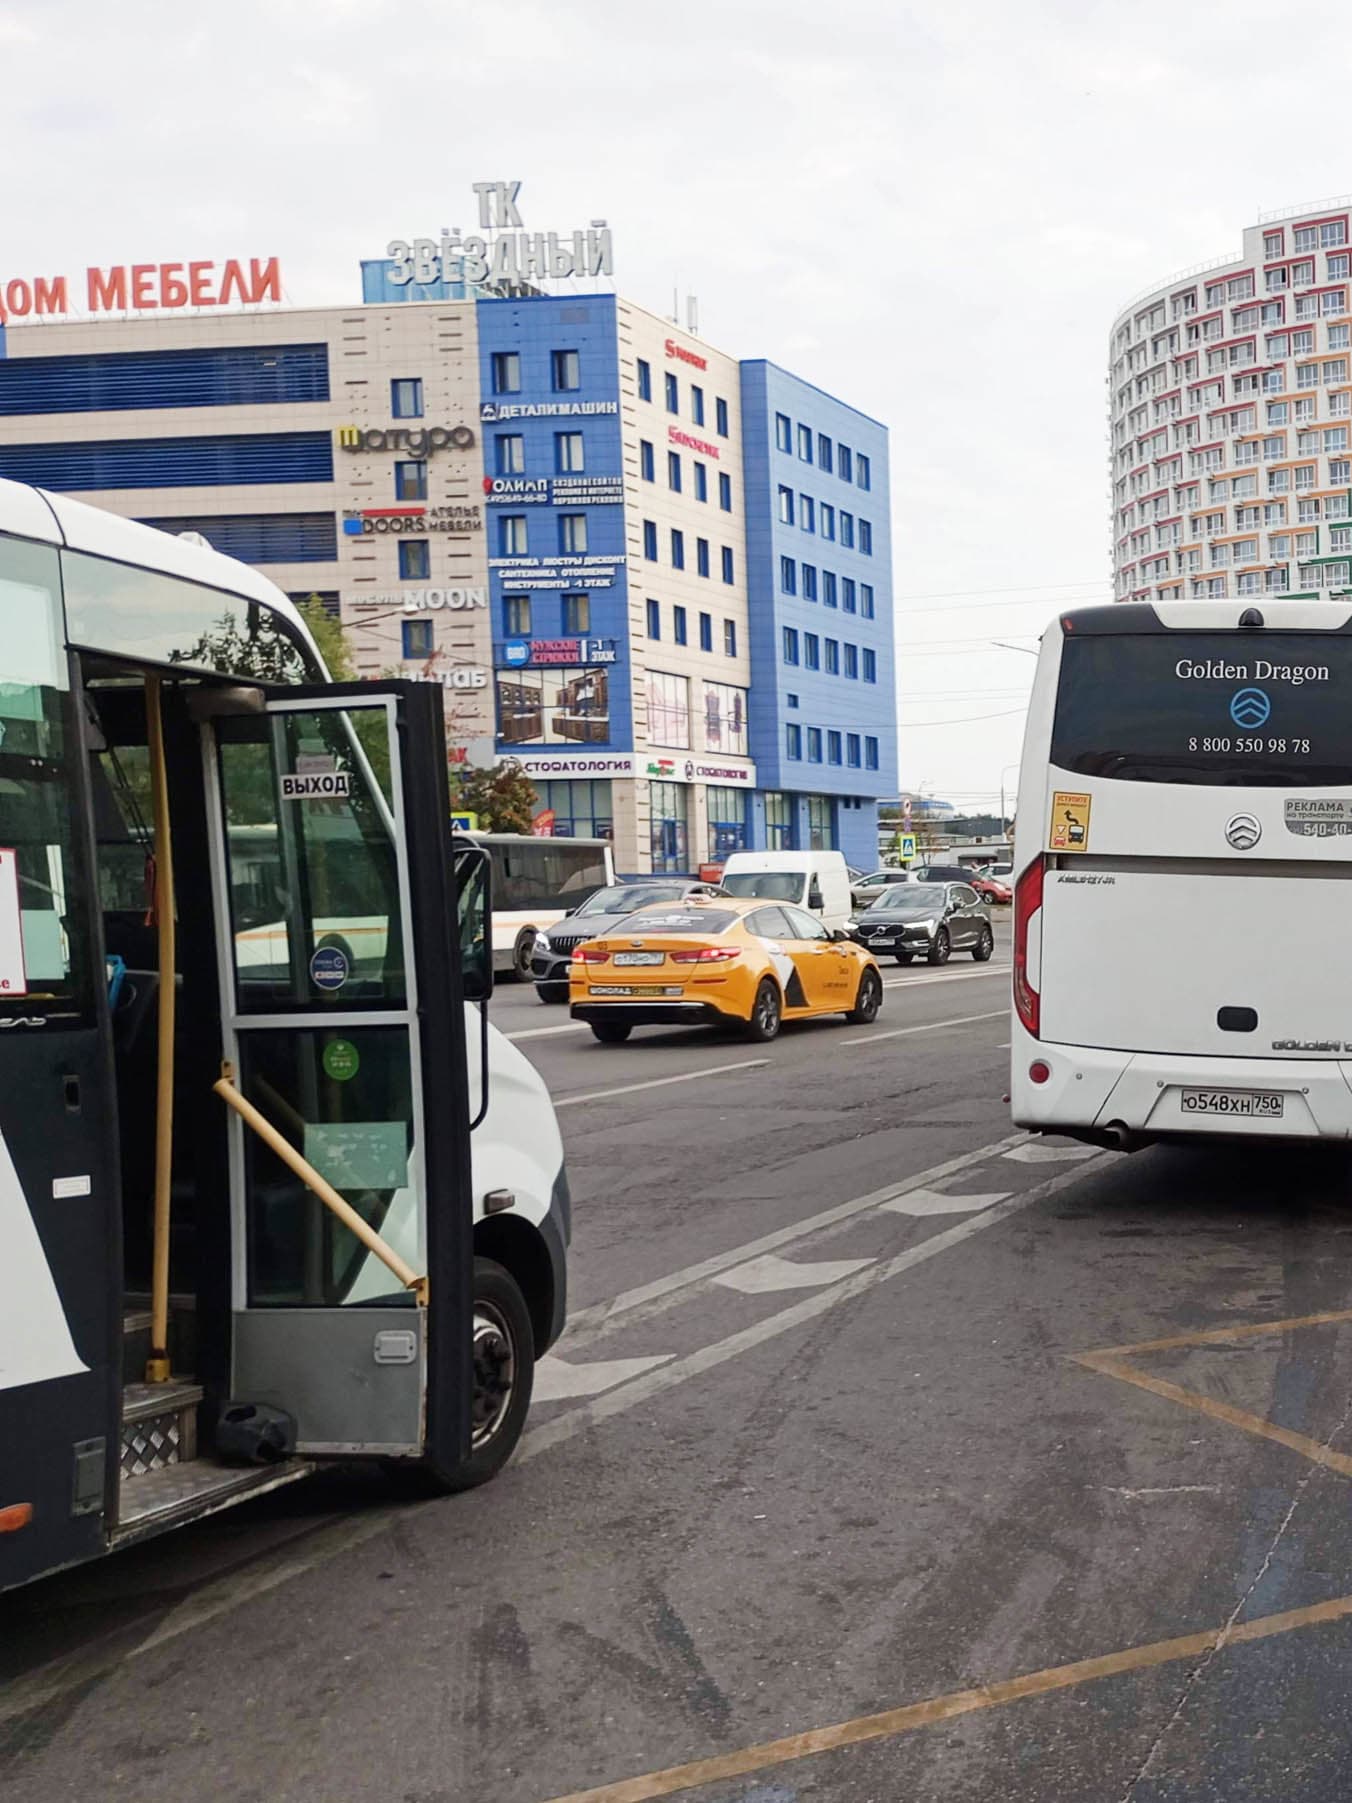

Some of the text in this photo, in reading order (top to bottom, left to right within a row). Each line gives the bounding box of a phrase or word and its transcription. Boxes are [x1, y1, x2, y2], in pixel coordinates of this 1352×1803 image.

[472, 180, 523, 229] ТК
[386, 219, 614, 288] ЗВЁЗДНЫЙ
[0, 256, 281, 322] ОМ МЕБЕЛИ
[492, 478, 548, 492] ОЛИМП
[362, 517, 425, 534] DOORS
[403, 588, 487, 610] MOON
[1175, 659, 1329, 684] Golden Dragon
[1188, 737, 1311, 754] 8 800 550 98 78
[283, 775, 348, 795] ВЫХОД
[1286, 801, 1345, 812] РЕКЛАМА
[1271, 1040, 1341, 1053] GOLDEN
[1186, 1093, 1279, 1114] О548ХН 750
